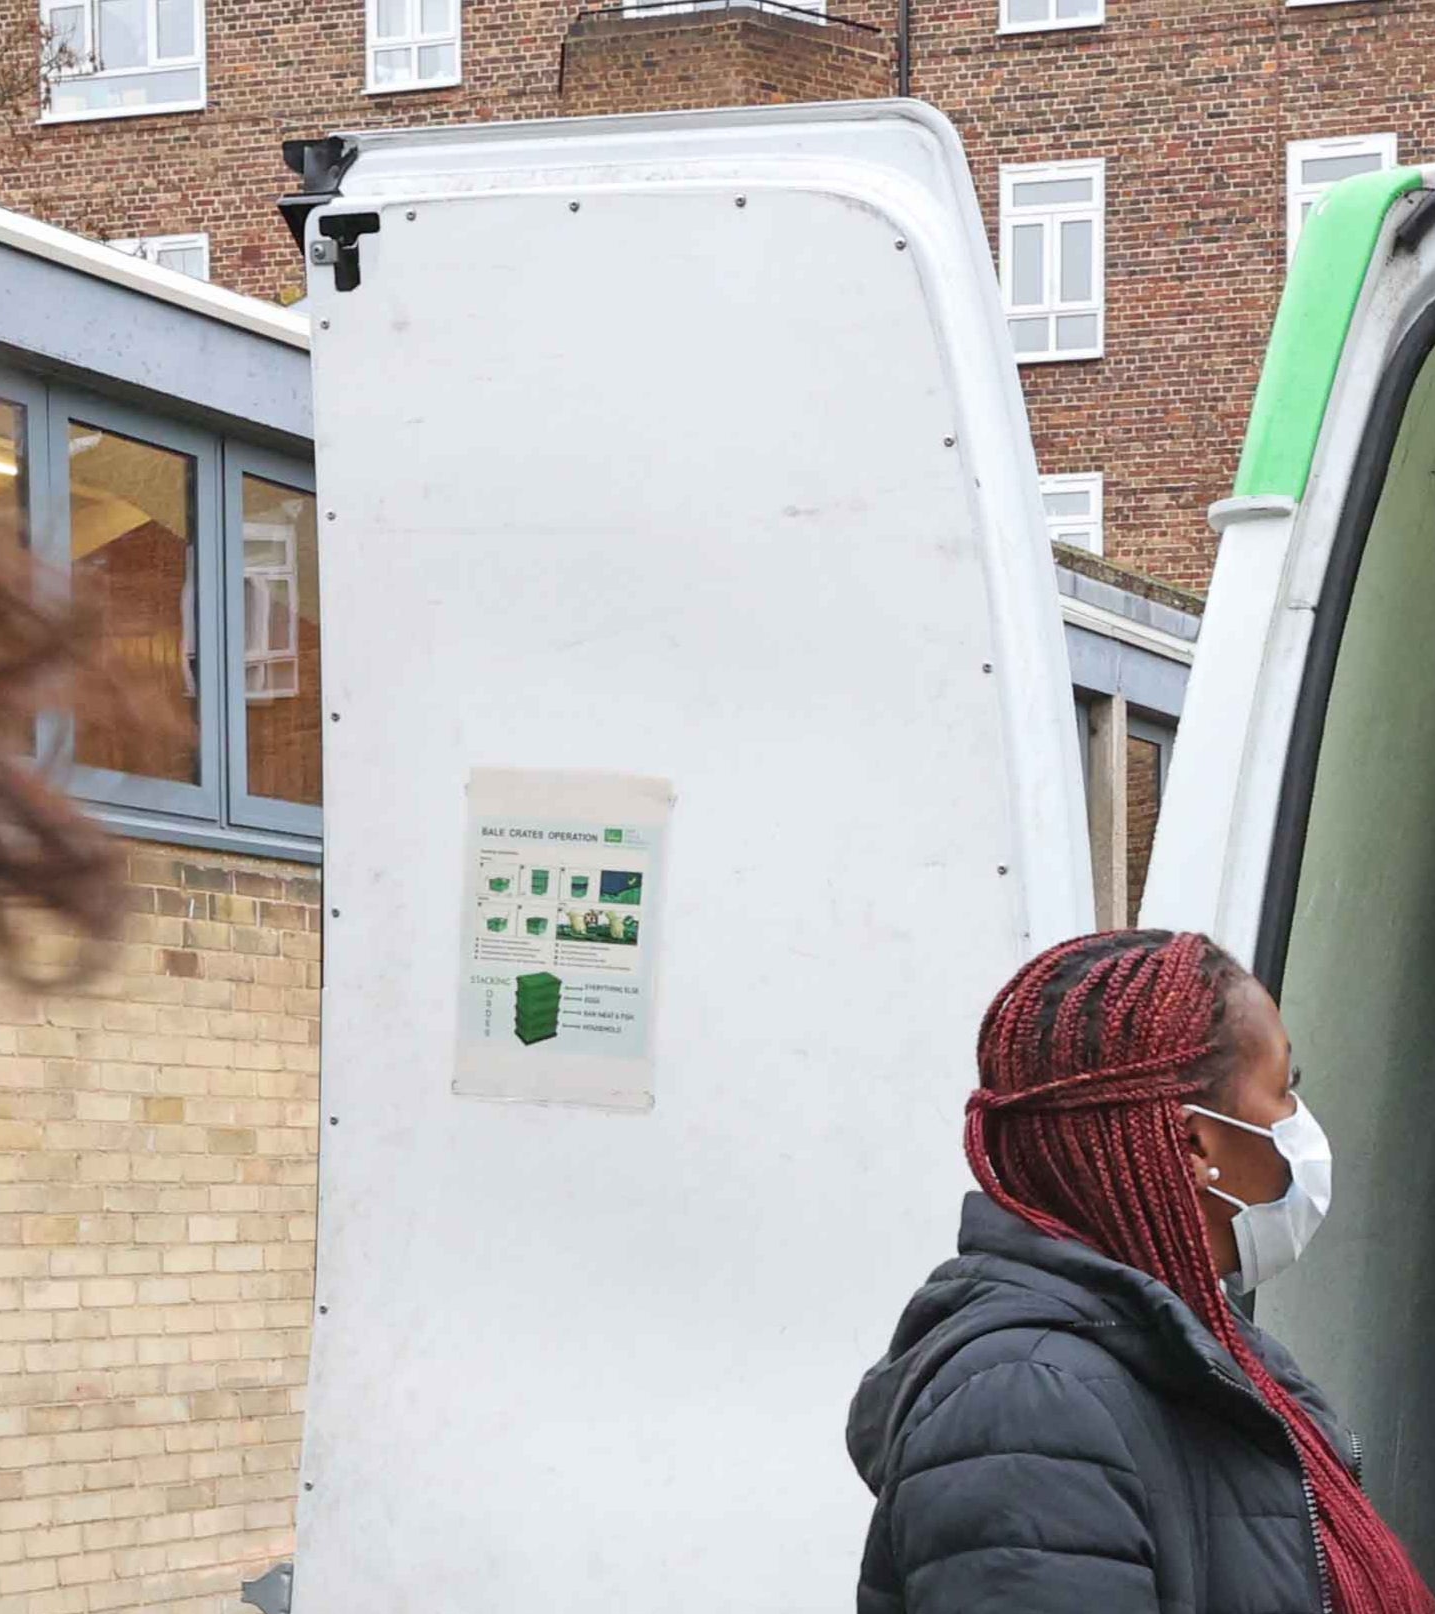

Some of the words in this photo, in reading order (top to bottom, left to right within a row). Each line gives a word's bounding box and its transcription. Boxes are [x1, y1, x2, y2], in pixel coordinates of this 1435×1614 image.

[481, 827, 504, 837] BALE
[509, 828, 544, 840] CRATES
[547, 830, 598, 842] OPERATION
